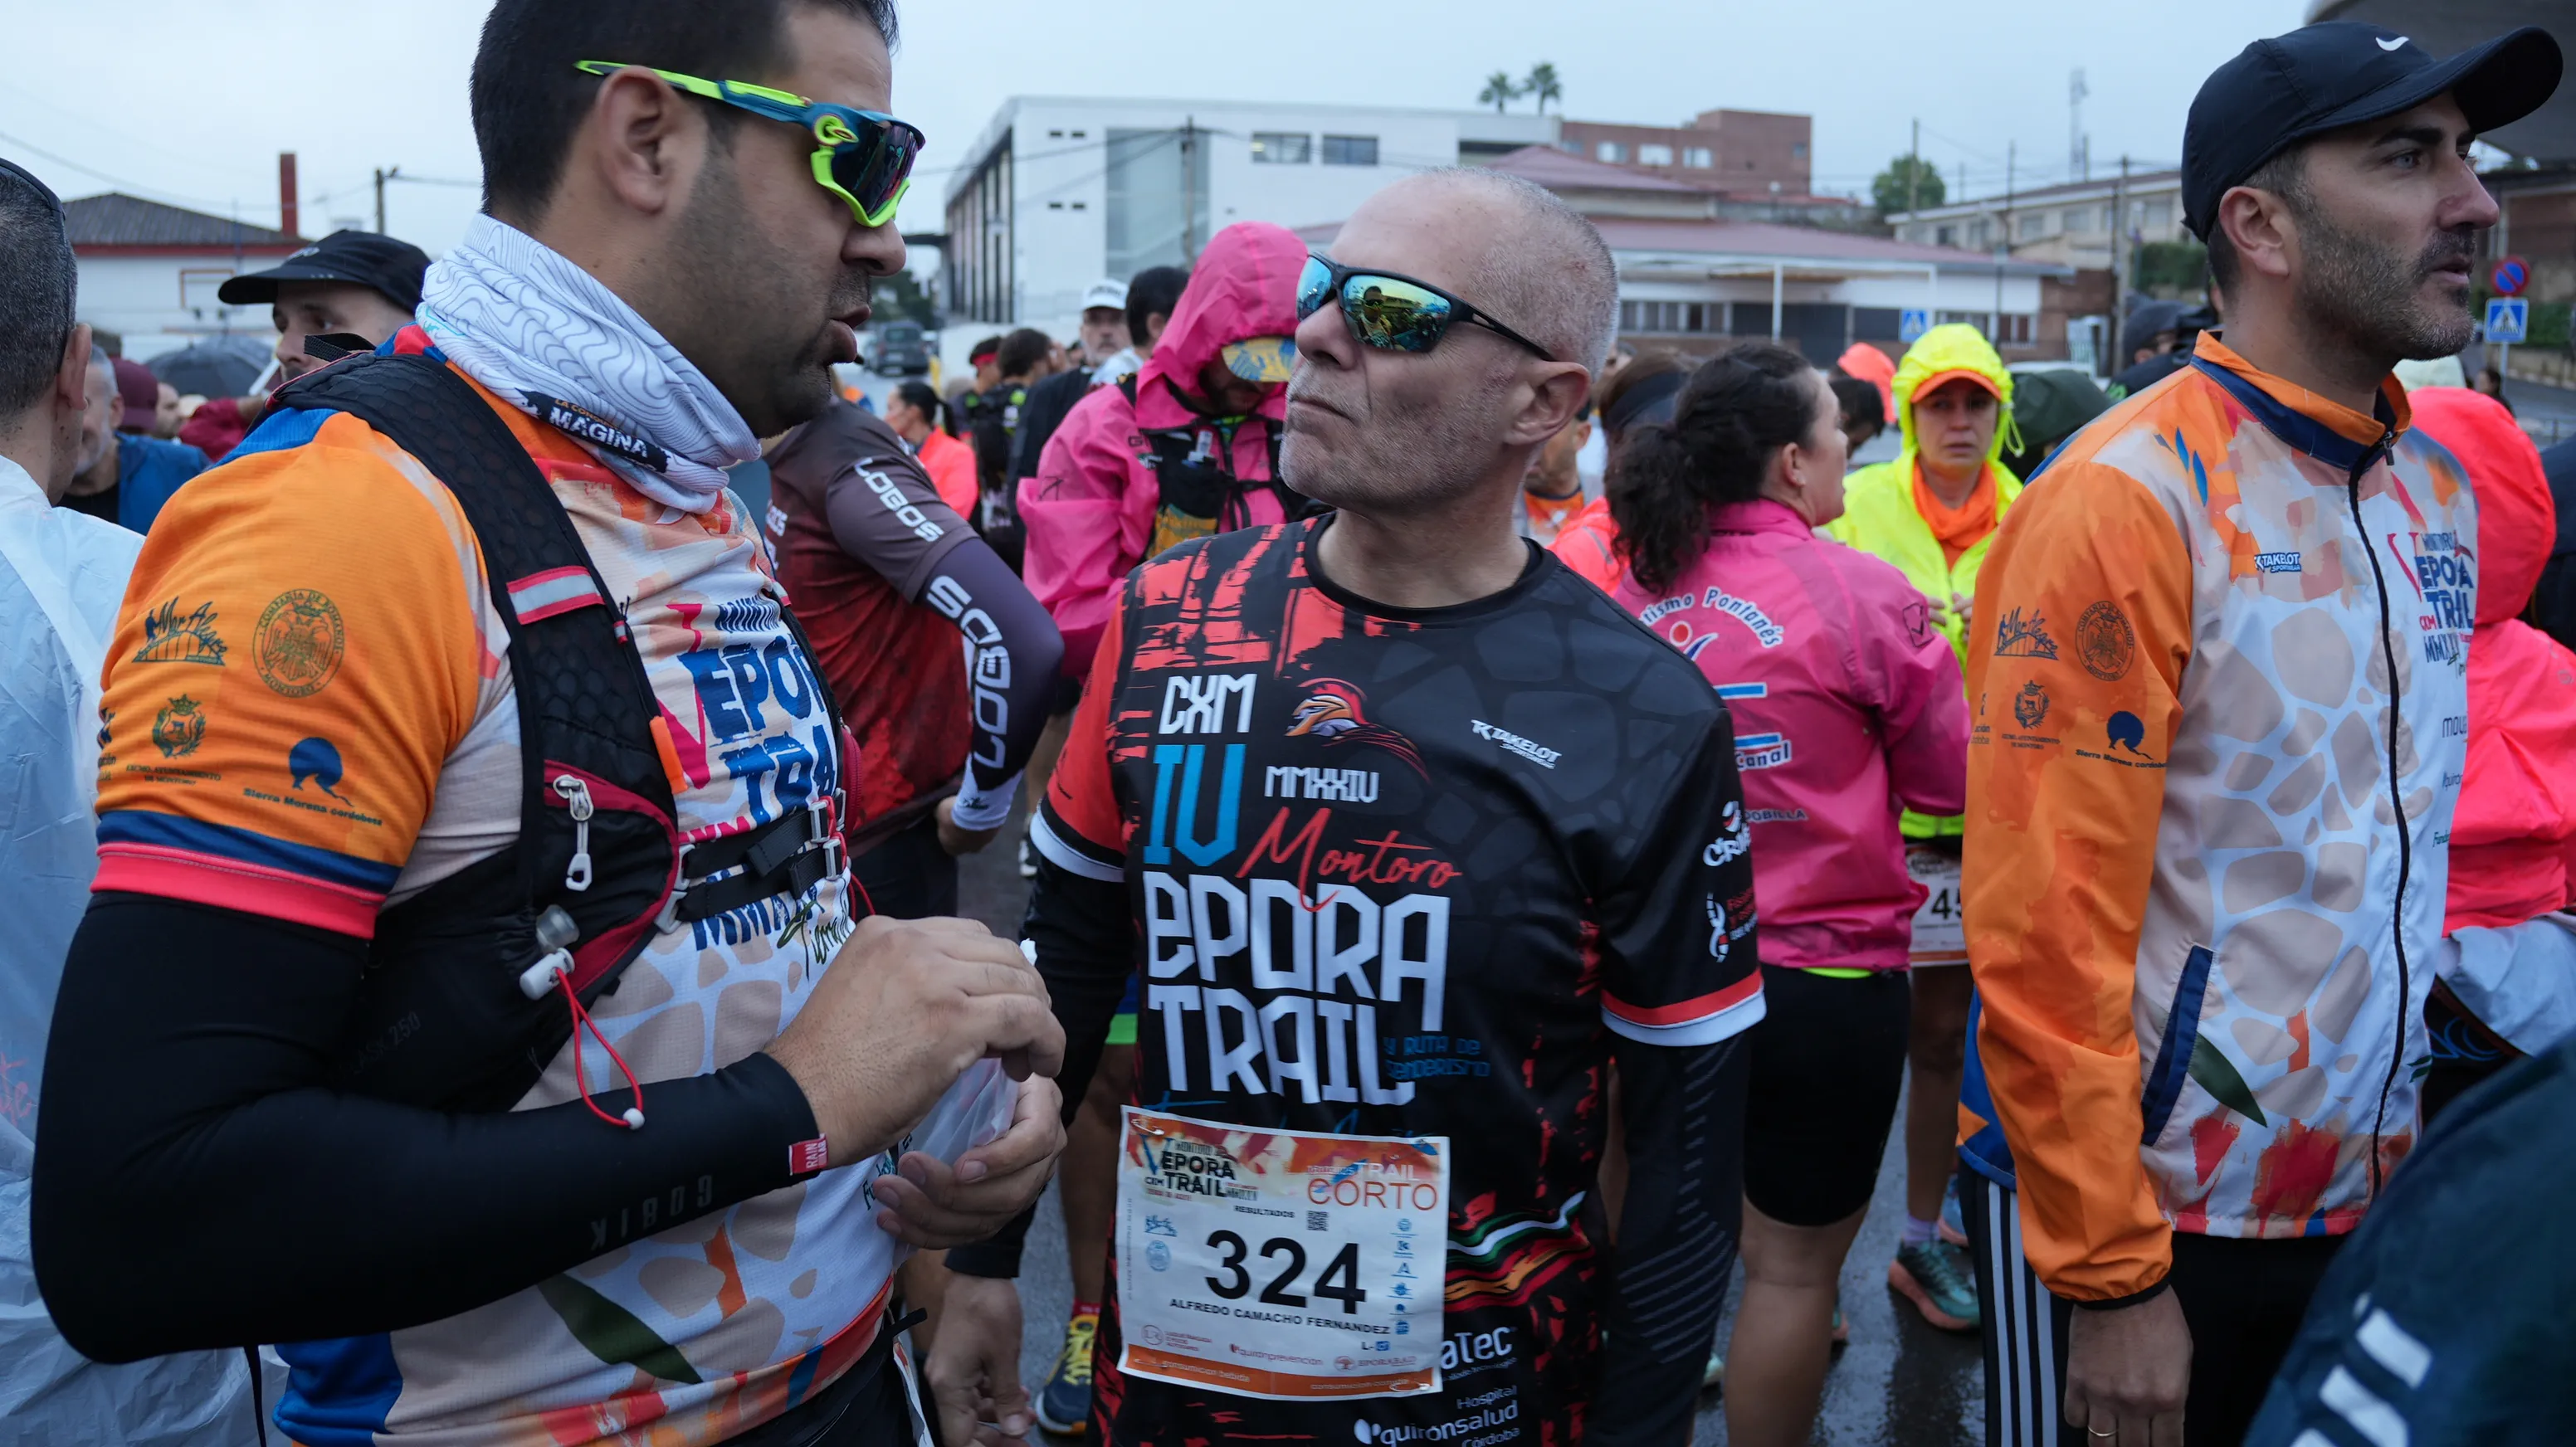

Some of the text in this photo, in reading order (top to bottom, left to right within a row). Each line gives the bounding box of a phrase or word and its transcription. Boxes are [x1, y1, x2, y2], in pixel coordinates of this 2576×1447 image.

[854, 457, 945, 543] LOBOS
[2261, 553, 2300, 567] TAKELOT
[2414, 555, 2475, 589] EPOA
[1642, 588, 1783, 646] tismo Pontanés
[2075, 748, 2101, 760] Sierra
[2103, 753, 2133, 767] Morena
[242, 787, 281, 803] Sierra
[283, 796, 328, 813] Morena
[1235, 806, 1463, 913] Montoro
[1147, 983, 1416, 1106] TRAIL
[804, 1142, 818, 1170] RAIN
[1161, 1150, 1236, 1180] EPORA
[1354, 1162, 1421, 1181] TRAIL
[1163, 1171, 1227, 1197] TRAIL
[1307, 1177, 1438, 1211] CORTO
[590, 1174, 714, 1249] GOBIK
[1233, 1205, 1295, 1219] RESULTADOS
[1205, 1229, 1367, 1315] 324
[1168, 1298, 1392, 1335] ALFREDO CAMACHO FERNANDEZ
[1456, 1386, 1518, 1410] Hospital
[1379, 1401, 1520, 1447] quirónsalud
